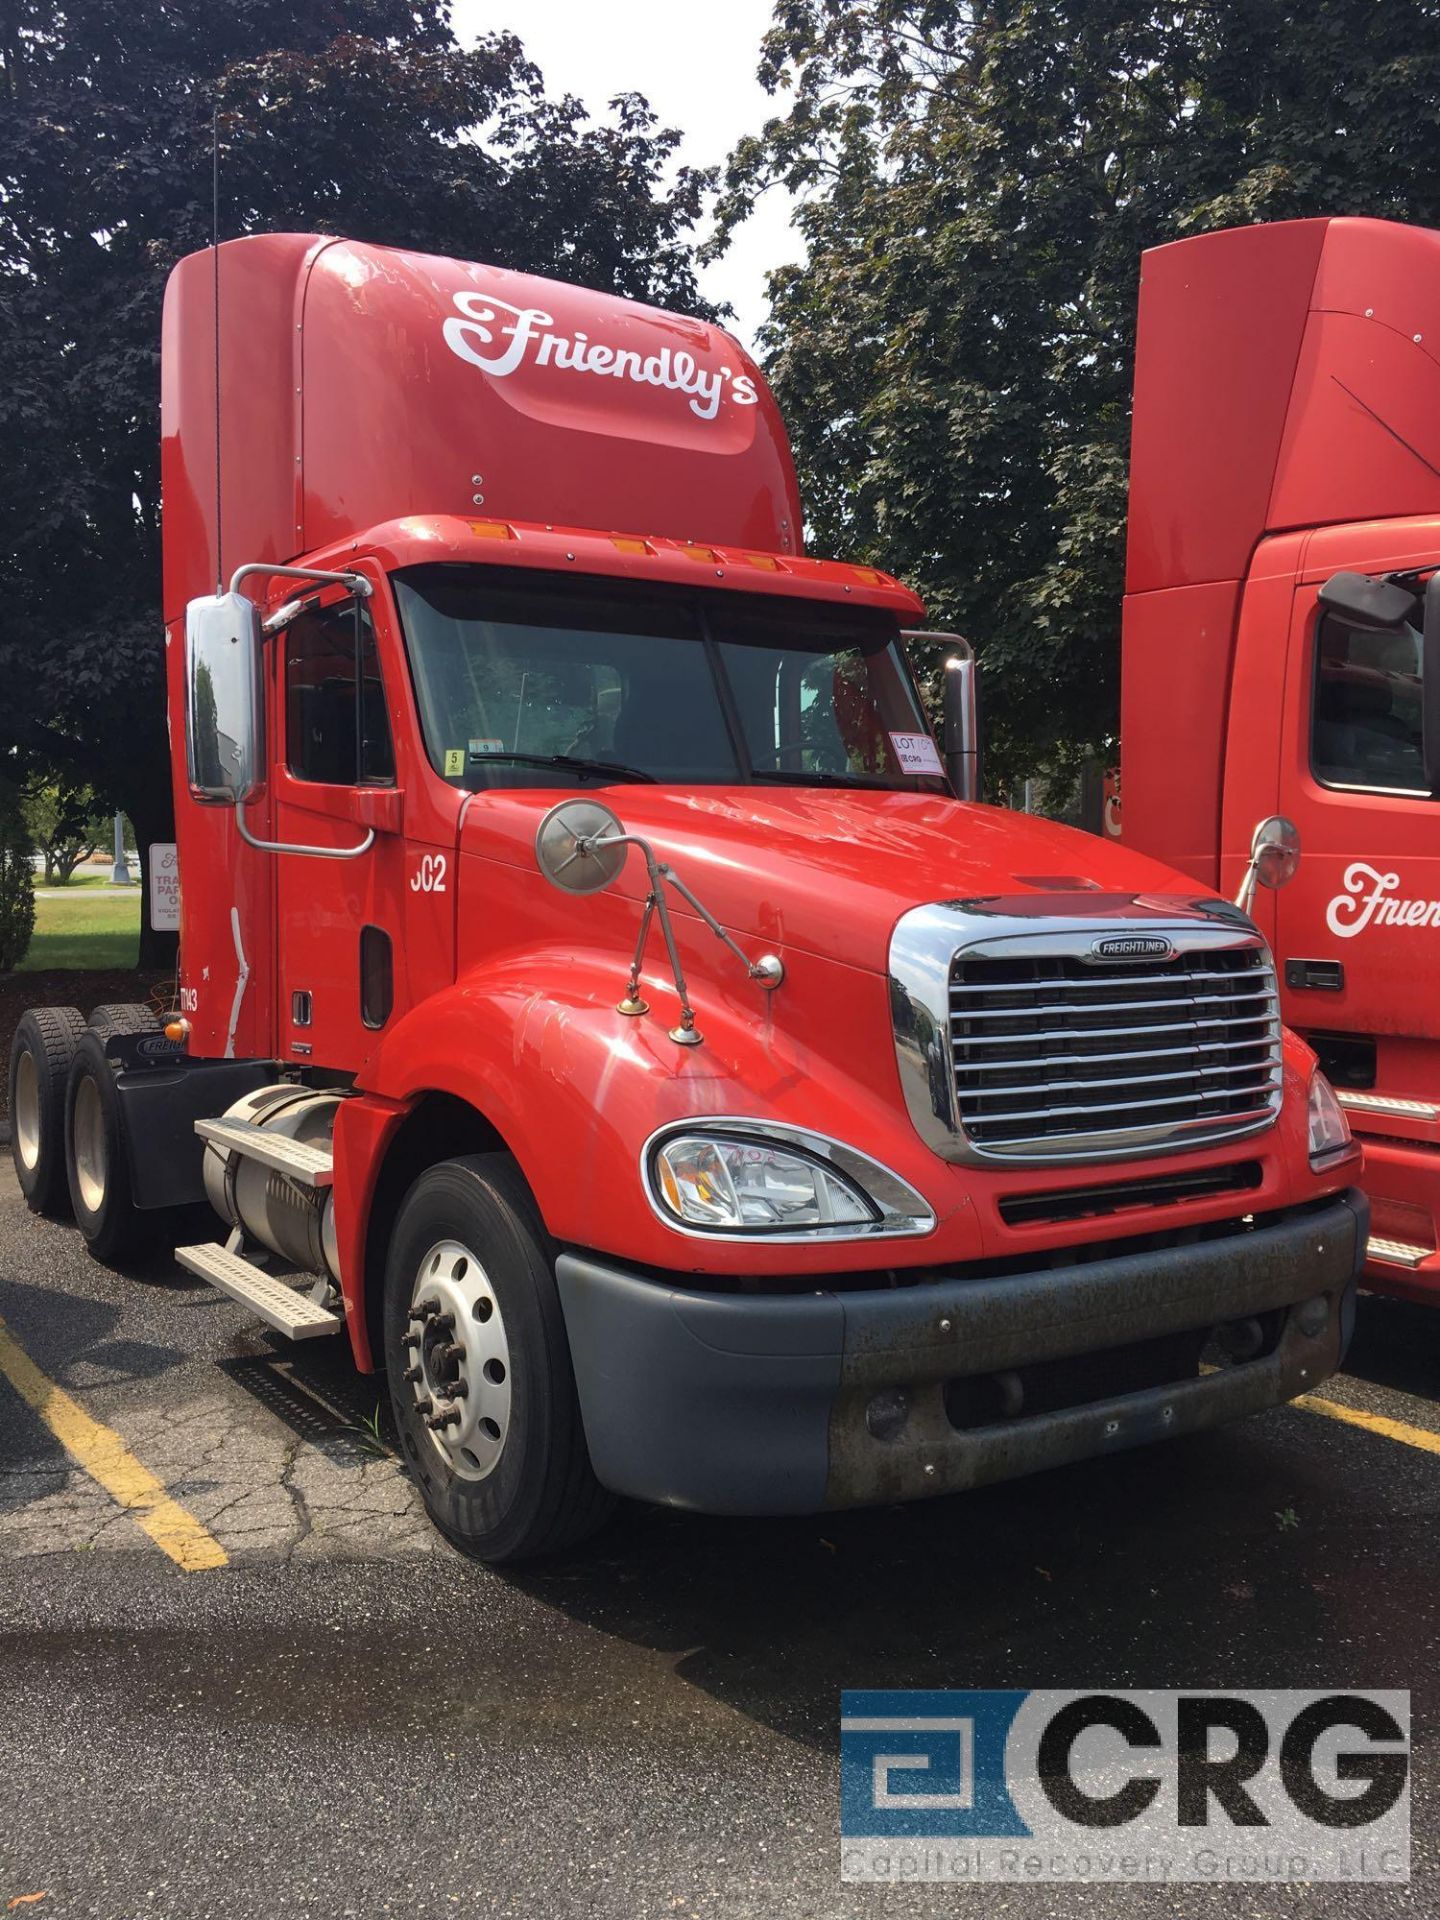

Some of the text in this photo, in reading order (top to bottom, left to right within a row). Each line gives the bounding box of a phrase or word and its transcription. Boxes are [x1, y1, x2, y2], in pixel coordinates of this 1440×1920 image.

[442, 291, 758, 419] Friendly's
[894, 737, 915, 749] LOT
[451, 752, 458, 764] 5
[1103, 941, 1165, 953] FREIGHTLINER
